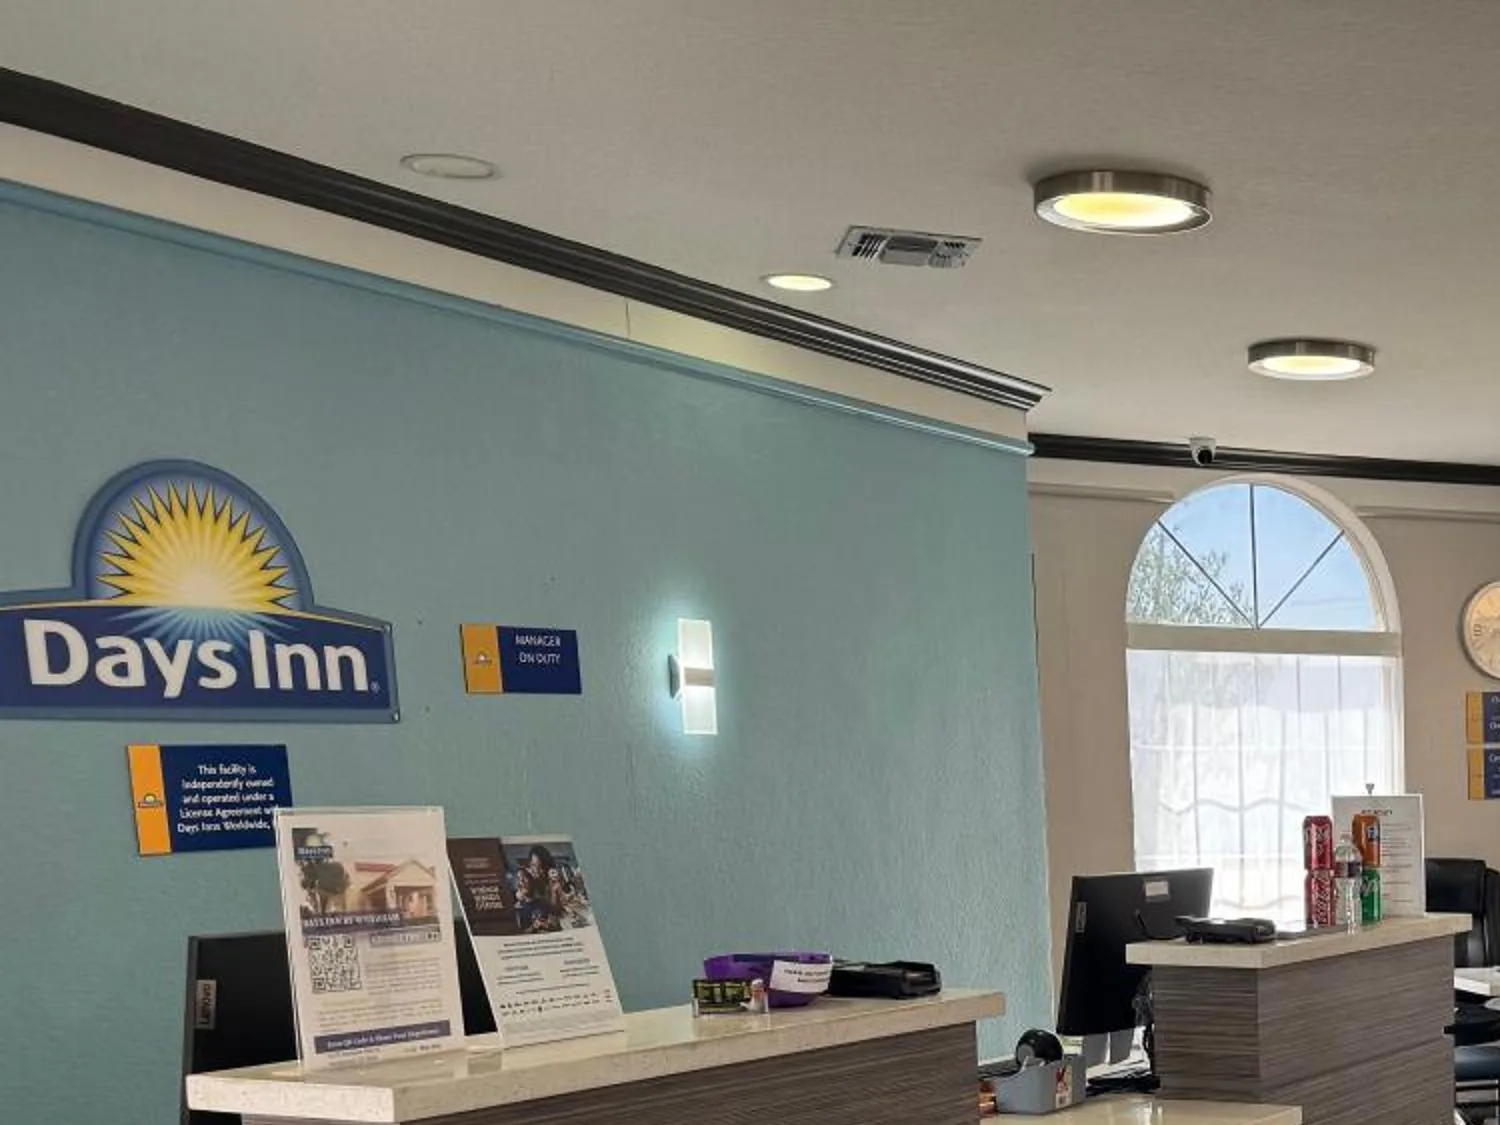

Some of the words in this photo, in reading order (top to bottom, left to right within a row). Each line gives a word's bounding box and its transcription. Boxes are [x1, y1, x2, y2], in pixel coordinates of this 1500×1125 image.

[514, 635, 561, 646] MANAGER
[24, 619, 237, 698] Days
[249, 629, 369, 691] Inn
[519, 652, 535, 663] ON
[536, 653, 561, 664] DUTY
[198, 764, 217, 775] This
[219, 763, 247, 776] facility
[248, 764, 257, 774] is
[245, 777, 275, 787] owned
[183, 793, 199, 804] and
[202, 792, 239, 805] operated
[241, 792, 267, 801] under
[268, 793, 275, 801] a
[180, 808, 214, 818] License
[215, 806, 262, 818] Agreement
[177, 823, 199, 834] Days
